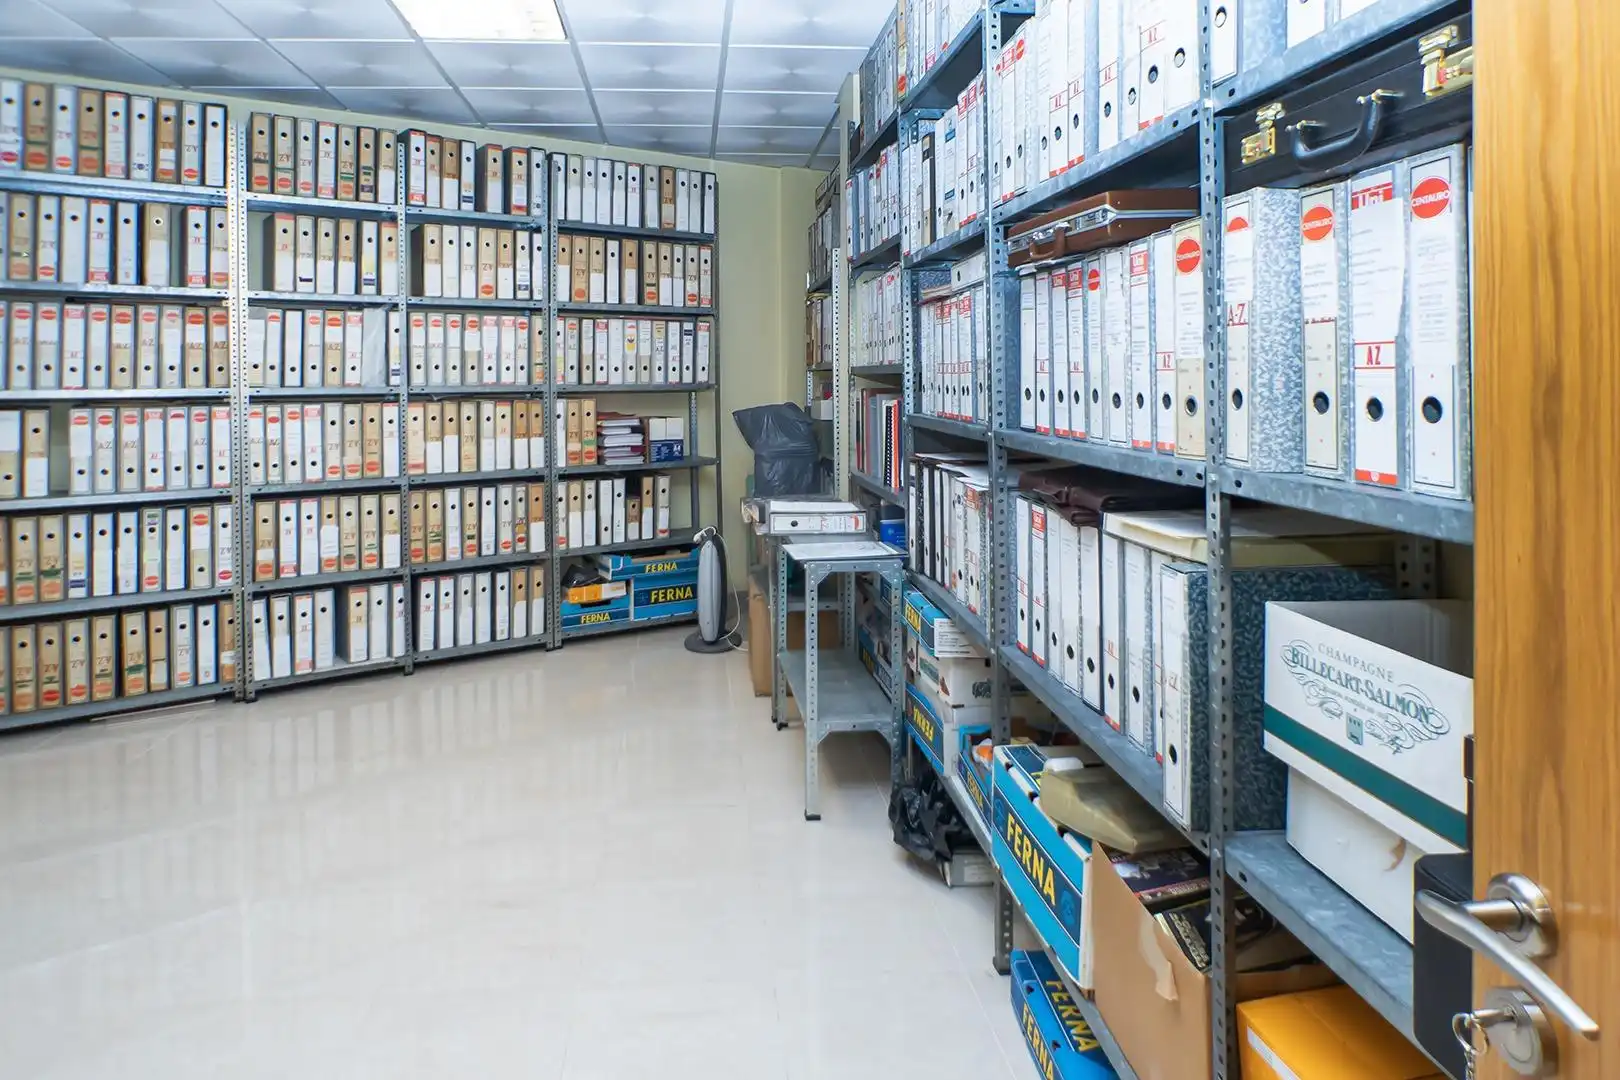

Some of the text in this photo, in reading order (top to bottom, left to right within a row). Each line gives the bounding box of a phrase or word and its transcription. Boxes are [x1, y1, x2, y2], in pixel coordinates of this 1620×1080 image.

[1411, 189, 1451, 207] CENTAURO
[1302, 217, 1333, 231] CENTAURO
[1366, 346, 1381, 365] AZ
[645, 562, 678, 574] FERNA
[650, 586, 693, 603] FERNA
[580, 612, 611, 624] FERNA
[1318, 642, 1394, 684] CHAMPAGNE
[1291, 646, 1435, 724] BILLECART-SALMON
[913, 706, 935, 742] FERNA
[966, 769, 984, 811] FERNA
[1007, 812, 1056, 906] FERNA
